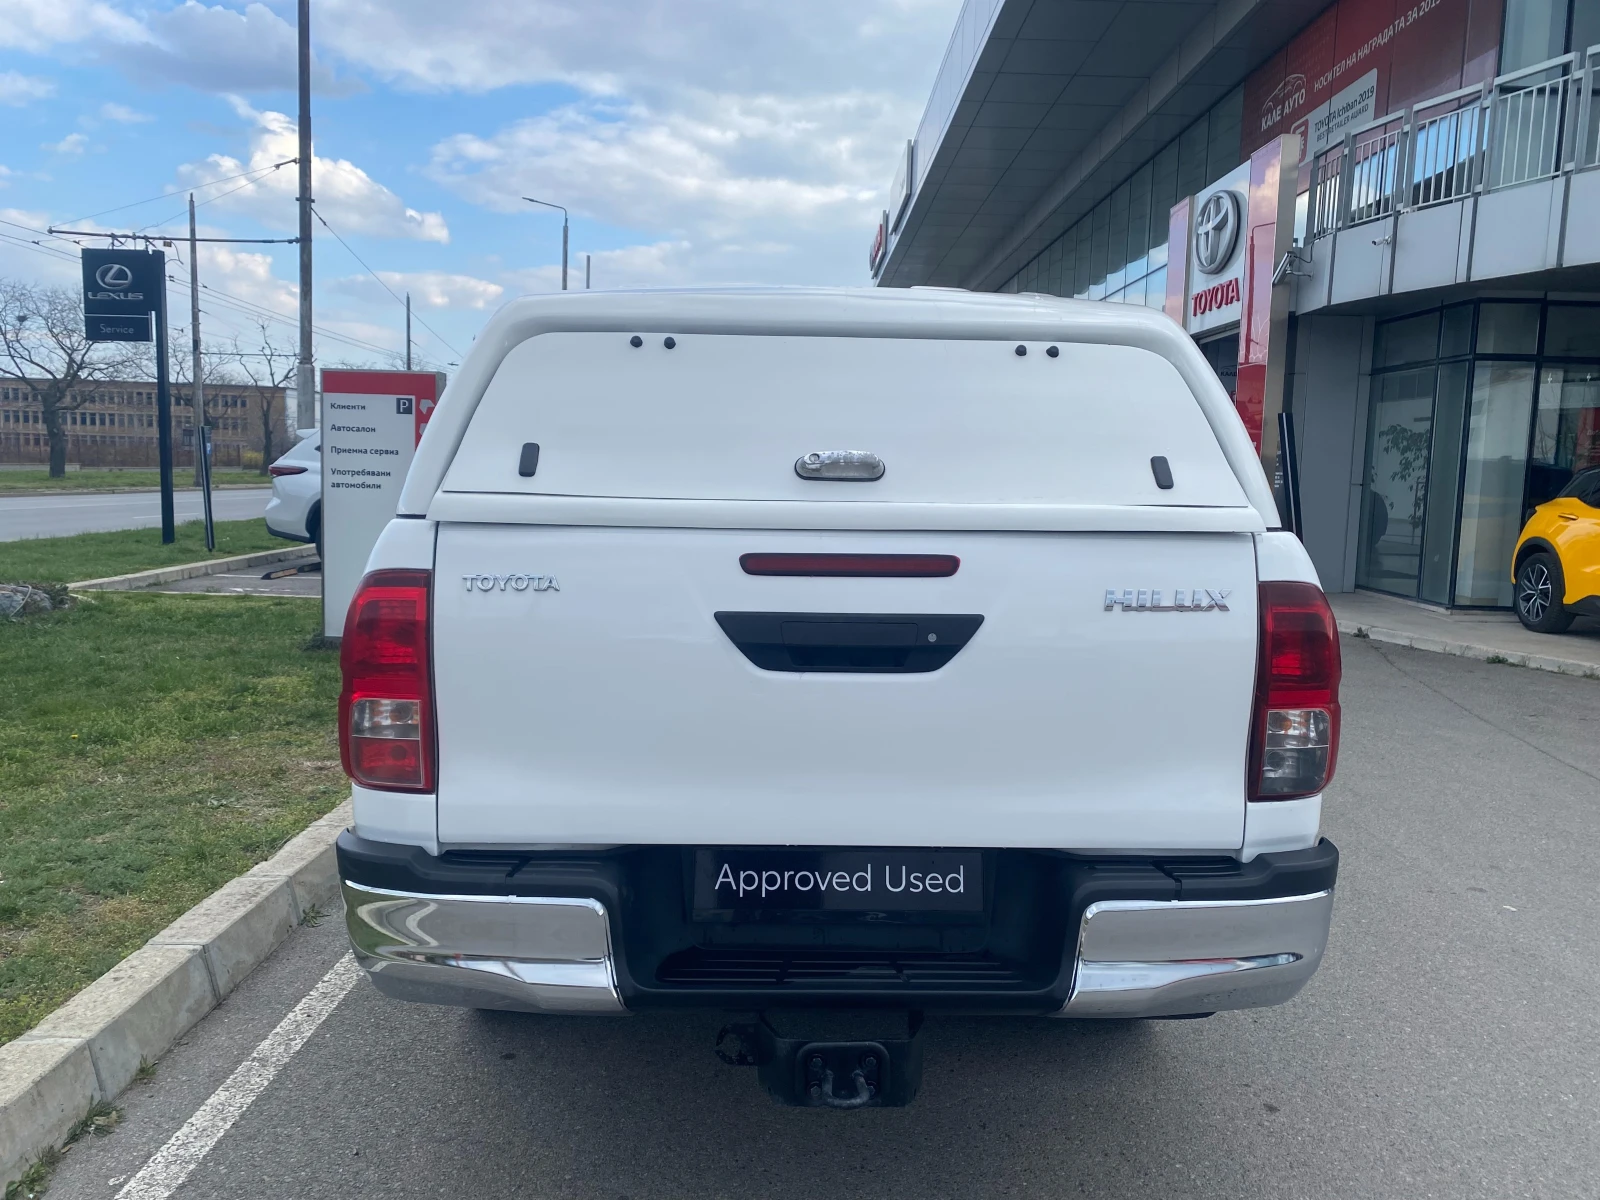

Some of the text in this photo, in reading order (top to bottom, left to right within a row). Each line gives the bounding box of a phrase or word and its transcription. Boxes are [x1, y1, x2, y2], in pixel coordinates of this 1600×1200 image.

[1314, 60, 1346, 93] НОСИТЕЛ
[1346, 52, 1357, 69] НА
[1357, 15, 1405, 62] НАГРАДАТА
[1406, 7, 1418, 26] ЗА
[1261, 88, 1306, 132] КАЛЕ АУТО
[1314, 85, 1375, 133] TOYOTA Ichiban 2019
[1316, 129, 1328, 142] BEST
[1328, 115, 1350, 135] RETAILER
[1350, 103, 1369, 122] AWARD
[88, 291, 144, 300] LEXUS
[1191, 277, 1240, 317] TOYOTA
[99, 323, 135, 335] Service
[330, 402, 366, 411] Клиенти
[330, 424, 376, 434] Автосалон
[330, 446, 399, 458] Приемна сервиз
[330, 467, 391, 478] Употребявани
[330, 480, 382, 490] автомобили
[462, 574, 560, 593] TOYOTA
[1104, 588, 1233, 612] HILUX
[714, 863, 964, 898] Approved Used
